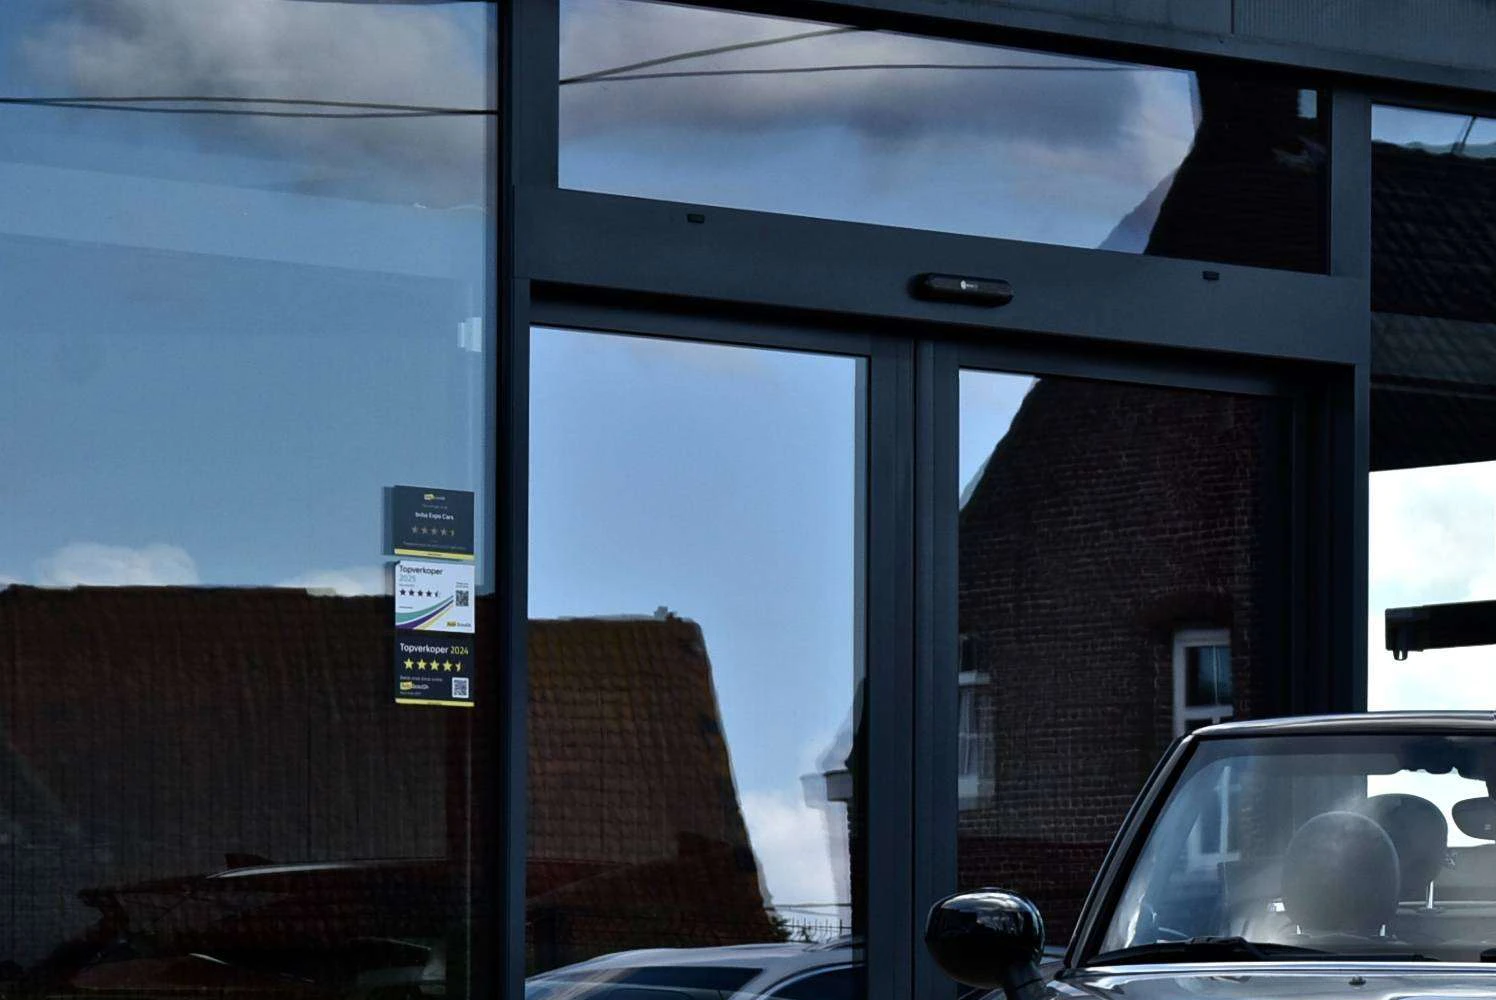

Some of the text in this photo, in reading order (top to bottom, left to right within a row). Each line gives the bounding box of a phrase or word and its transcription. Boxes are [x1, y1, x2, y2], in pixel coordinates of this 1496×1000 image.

[442, 513, 454, 521] Cars
[400, 565, 443, 576] Topverkoper
[400, 643, 469, 655] Topverkoper 2024
